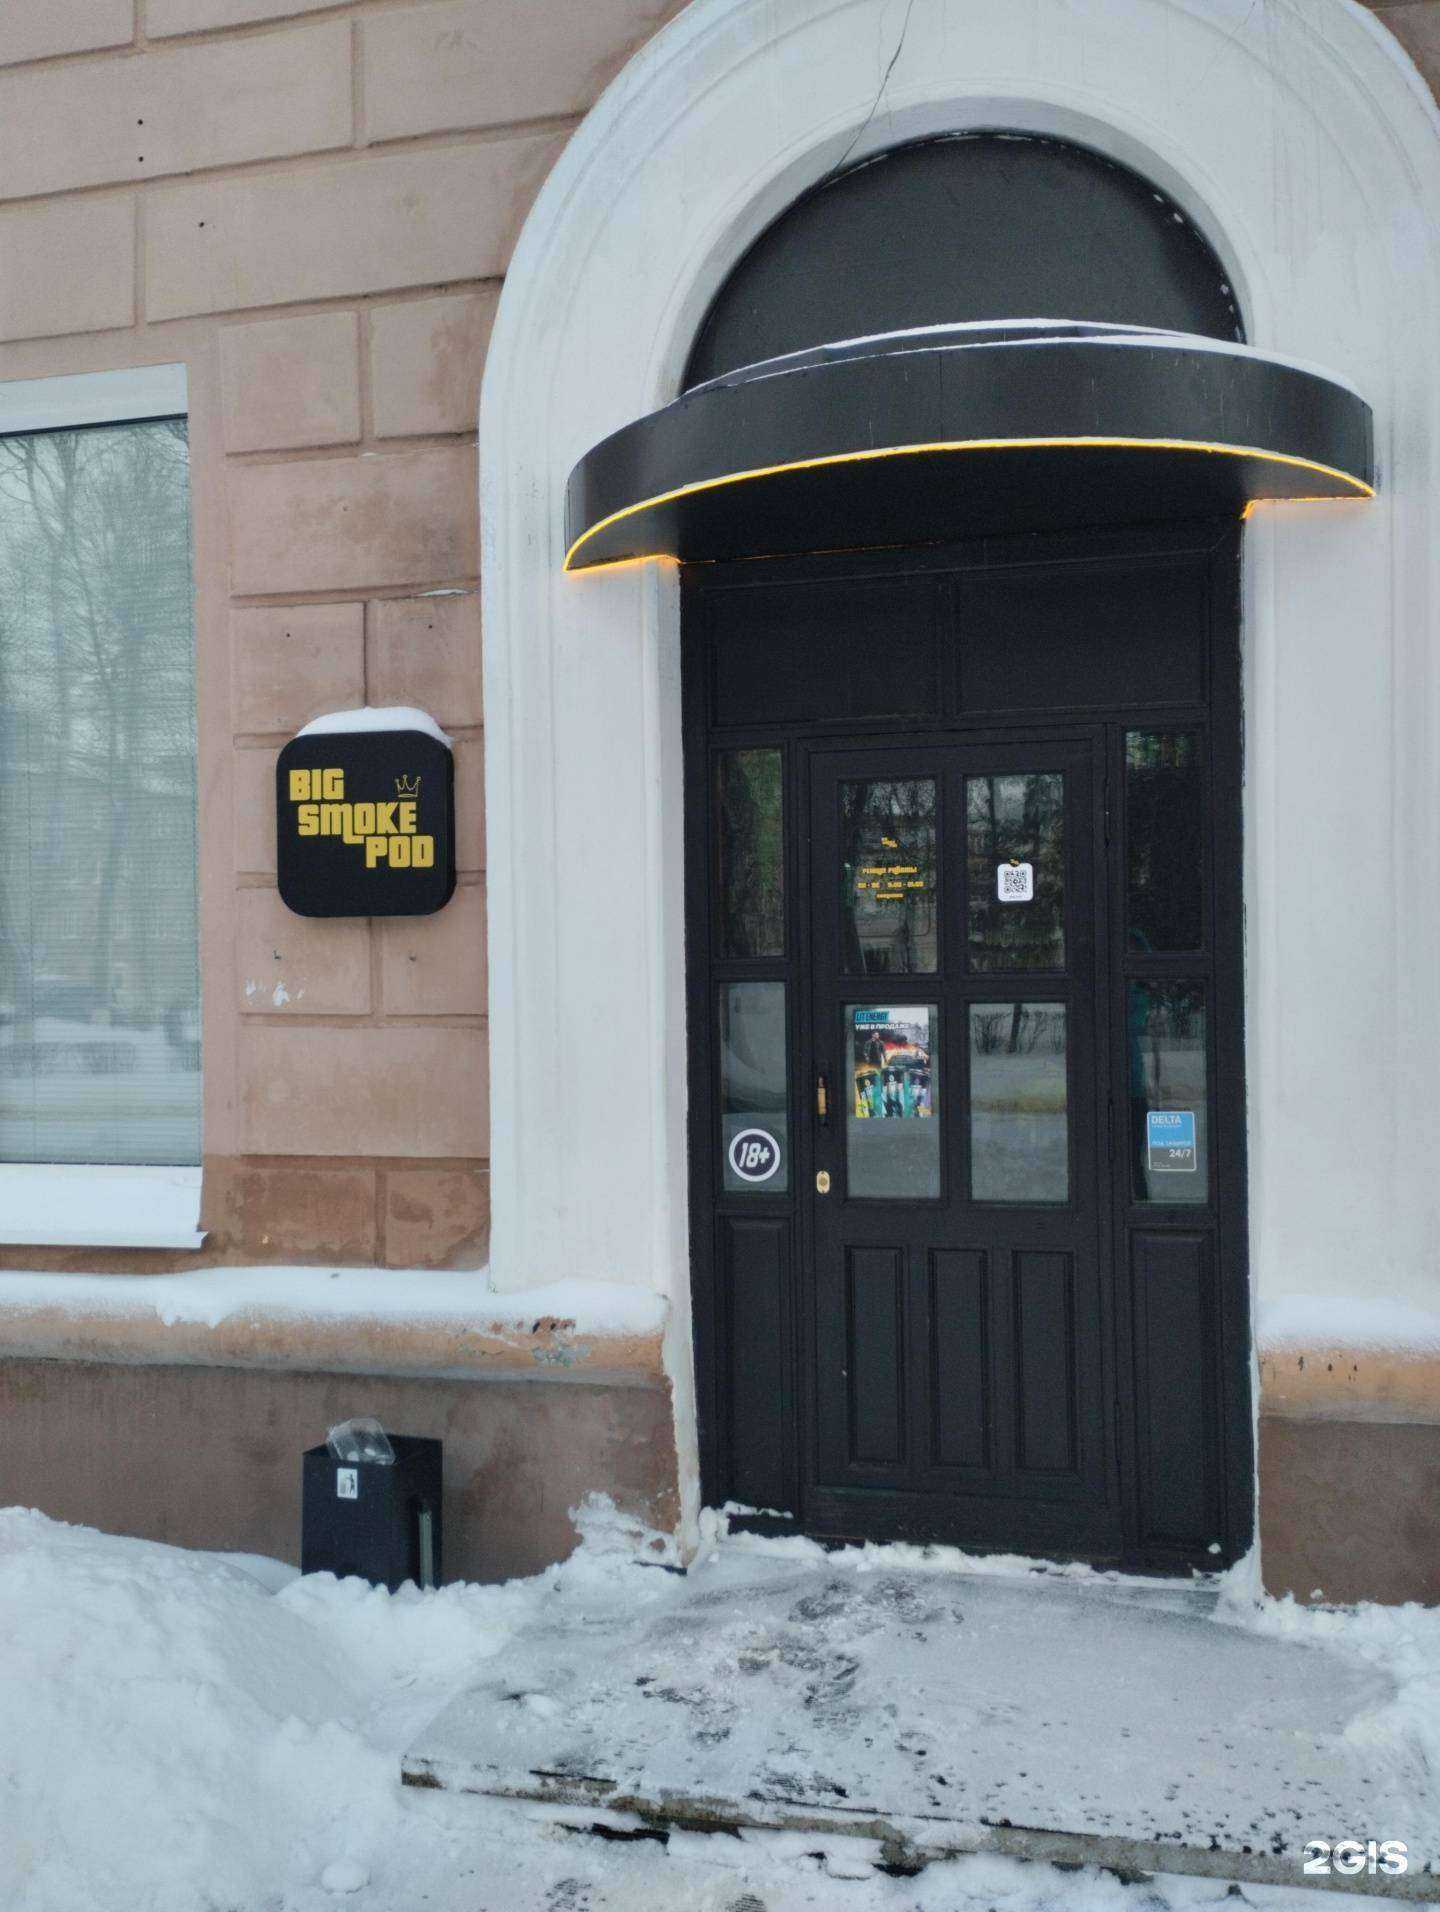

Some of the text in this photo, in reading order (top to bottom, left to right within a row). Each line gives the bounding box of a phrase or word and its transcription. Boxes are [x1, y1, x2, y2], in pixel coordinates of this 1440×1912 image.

[289, 768, 344, 801] BIG
[297, 801, 417, 844] SMOKE
[365, 835, 434, 869] POD
[1151, 1115, 1182, 1125] DELTA
[738, 1142, 771, 1168] 18+
[1168, 1148, 1192, 1158] 24/7
